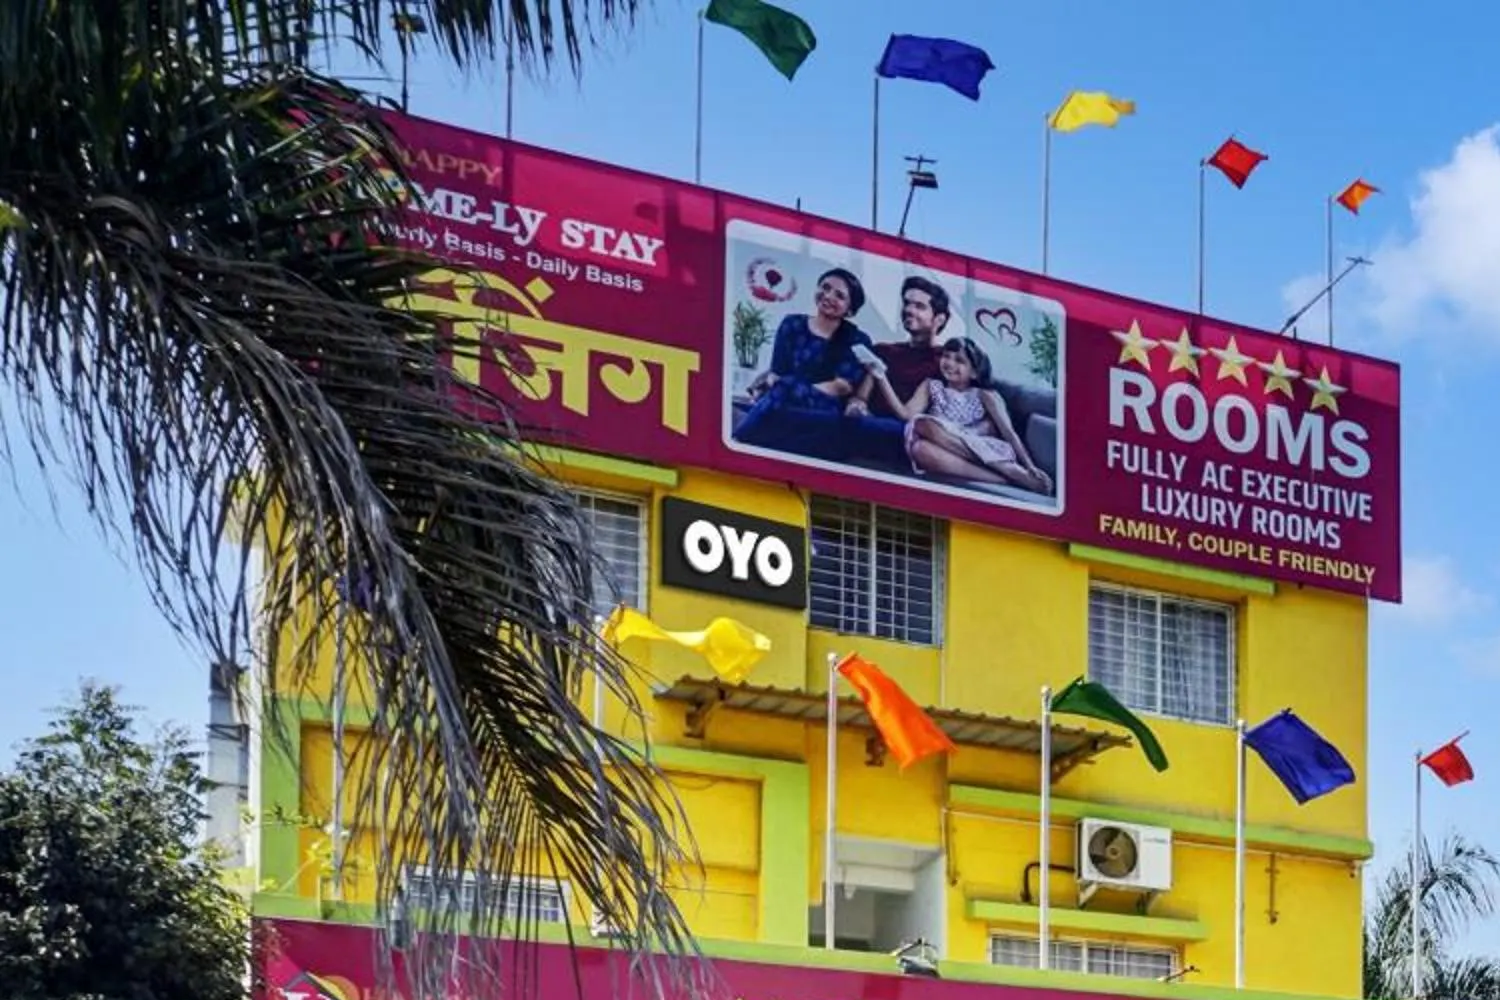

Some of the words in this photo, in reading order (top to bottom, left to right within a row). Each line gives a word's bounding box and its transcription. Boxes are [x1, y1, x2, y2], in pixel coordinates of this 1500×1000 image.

[363, 216, 438, 250] urly
[444, 230, 506, 262] Basis
[527, 252, 579, 281] Daily
[585, 265, 644, 293] Basis
[561, 218, 664, 267] STAY
[1108, 366, 1372, 479] ROOMS
[1106, 439, 1188, 483] FULLY
[1201, 460, 1235, 493] AC
[1241, 468, 1373, 522] EXECUTIVE
[1141, 483, 1244, 530] LUXURY
[1252, 506, 1342, 549] ROOMS
[683, 519, 793, 587] OYO
[1098, 514, 1182, 550] FAMILY,
[1188, 532, 1273, 565] COUPLE
[1278, 550, 1376, 585] FRIENDLY
